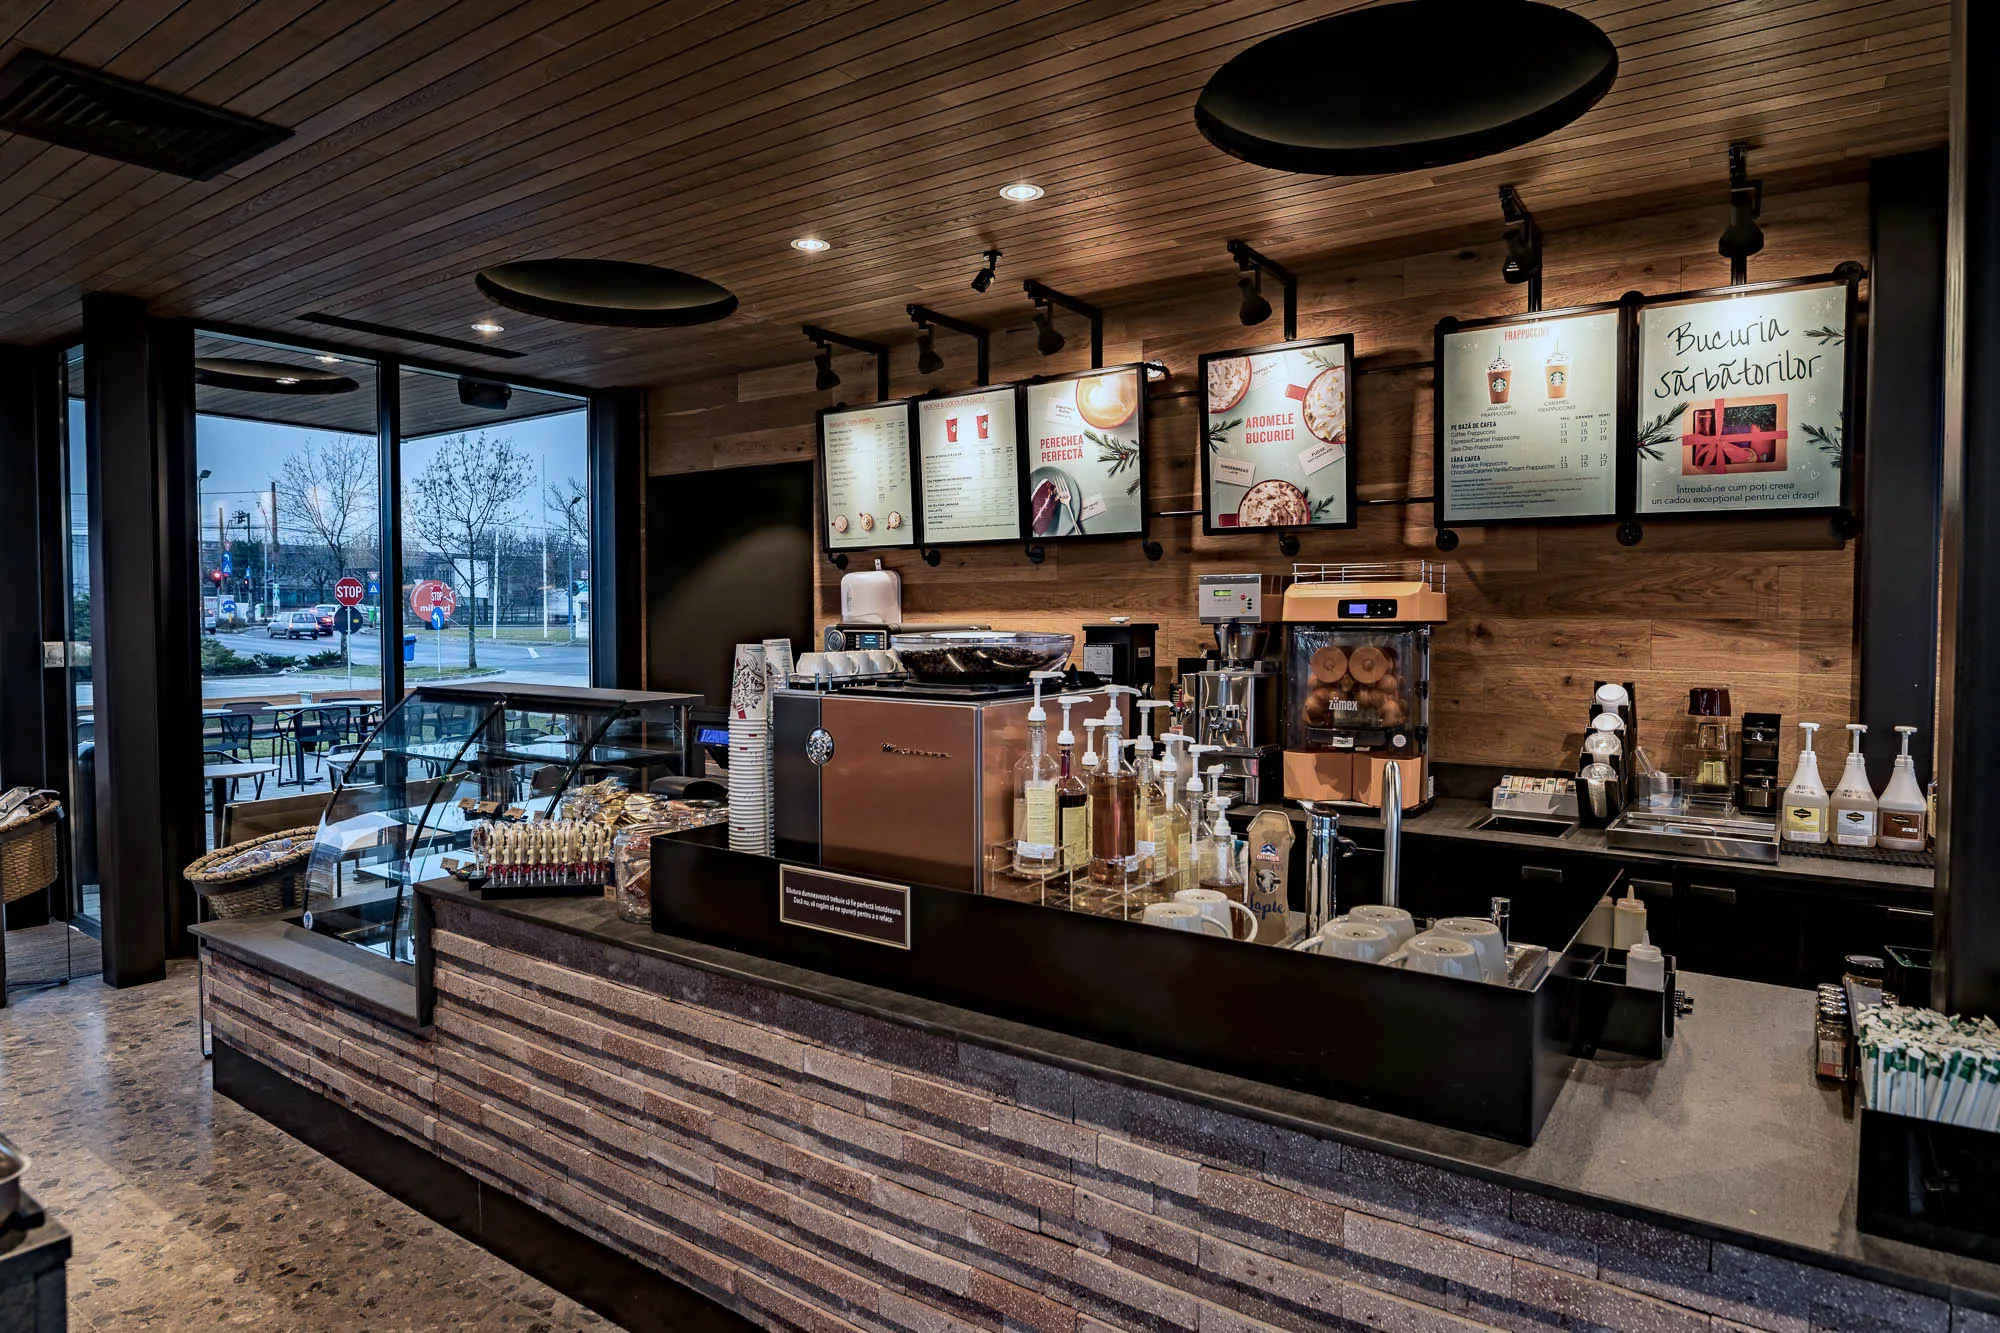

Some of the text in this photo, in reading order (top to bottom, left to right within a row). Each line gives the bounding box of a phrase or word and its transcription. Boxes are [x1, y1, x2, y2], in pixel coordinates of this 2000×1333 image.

[1667, 315, 1790, 356] Bucuria
[1246, 413, 1294, 429] AROMELE
[1040, 434, 1084, 449] PERECHEA
[1246, 429, 1294, 444] BUCURIEI
[1042, 446, 1084, 463] PERFECTĂ
[1676, 484, 1726, 494] Întreabă-ne
[1769, 482, 1795, 490] creea
[1664, 495, 1691, 504] cadou
[1745, 492, 1775, 502] pentru
[1777, 491, 1790, 500] cei
[1792, 490, 1820, 501] dragi!
[336, 586, 362, 598] STOP
[432, 592, 443, 601] STOP
[1328, 697, 1358, 711] zümex
[786, 886, 801, 895] Băutura
[794, 896, 803, 905] Dacă
